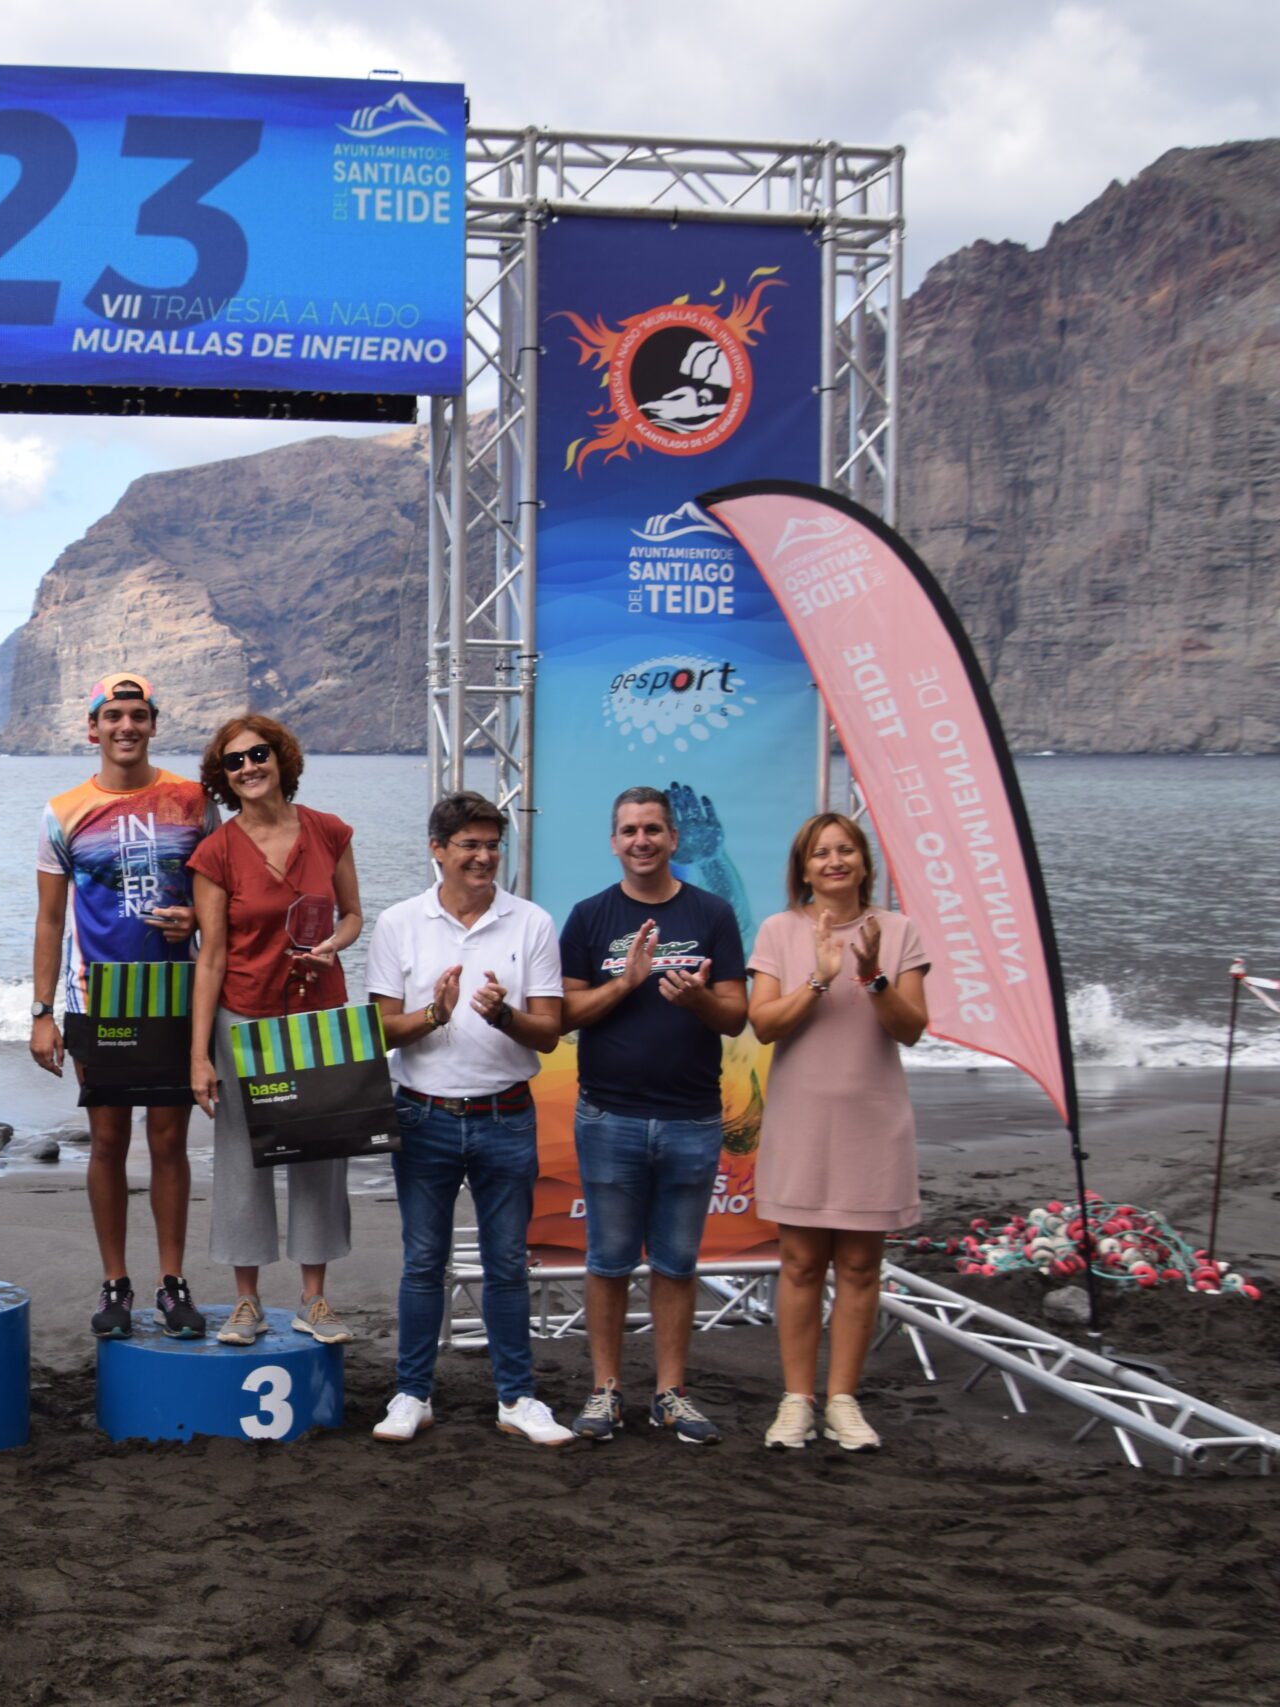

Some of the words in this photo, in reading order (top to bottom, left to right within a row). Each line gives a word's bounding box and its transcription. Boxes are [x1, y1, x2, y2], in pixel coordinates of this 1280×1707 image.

[333, 161, 451, 188] SANTIAGO
[332, 189, 349, 222] DEL
[351, 187, 451, 225] TEIDE
[102, 294, 142, 320] VII
[149, 292, 291, 324] TRAVESÍA
[296, 300, 321, 326] A
[328, 301, 421, 329] NADO
[72, 328, 243, 357] MURALLAS
[249, 333, 294, 358] DE
[300, 334, 448, 364] INFIERNO
[618, 327, 641, 359] NADO
[699, 315, 719, 334] DEL
[628, 561, 735, 583] SANTIAGO
[628, 586, 643, 614] DEL
[644, 584, 735, 615] TEIDE
[609, 662, 737, 696] gesport
[118, 811, 156, 842] IN
[123, 874, 160, 899] ER
[239, 1365, 293, 1440] 3
